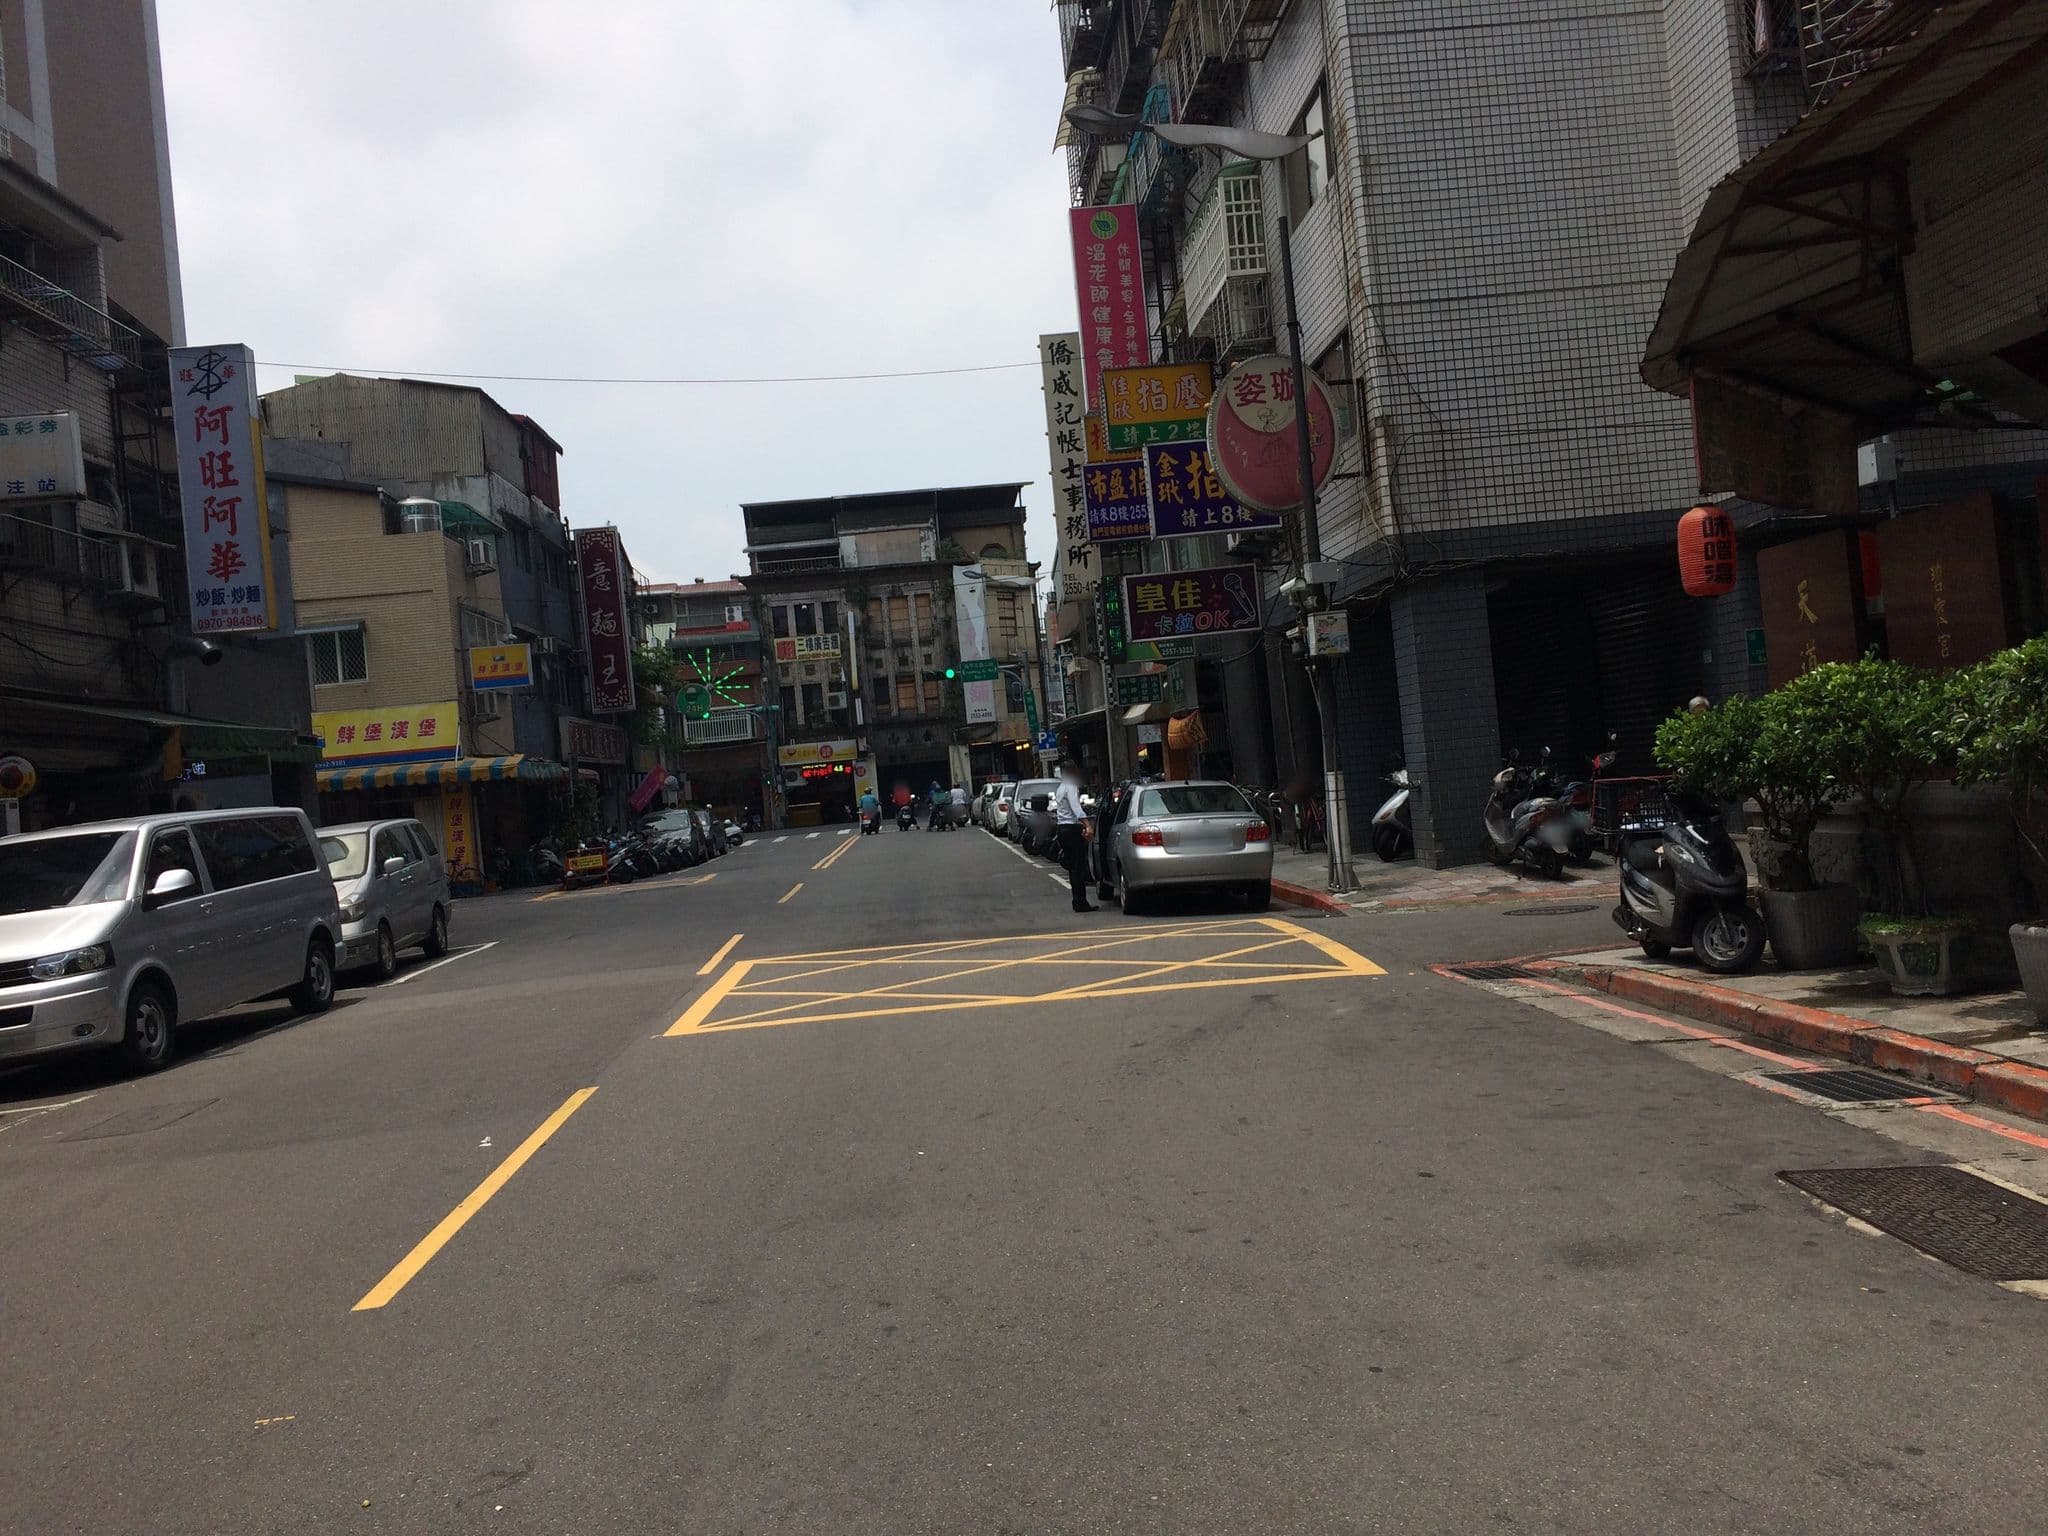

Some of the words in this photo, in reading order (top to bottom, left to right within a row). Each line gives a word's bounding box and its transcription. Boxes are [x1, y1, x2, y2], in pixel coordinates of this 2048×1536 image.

[179, 368, 194, 383] 旺
[1136, 373, 1205, 411] 指壓
[7, 479, 57, 495] 注站
[193, 404, 247, 583] 阿旺阿華
[1702, 515, 1736, 585] 味噌湯
[1063, 573, 1077, 581] TEL
[1135, 578, 1204, 614] 皇佳
[1154, 608, 1231, 635] 卡拉OK
[335, 717, 437, 744] 鮮堡漢堡
[1038, 732, 1047, 743] P
